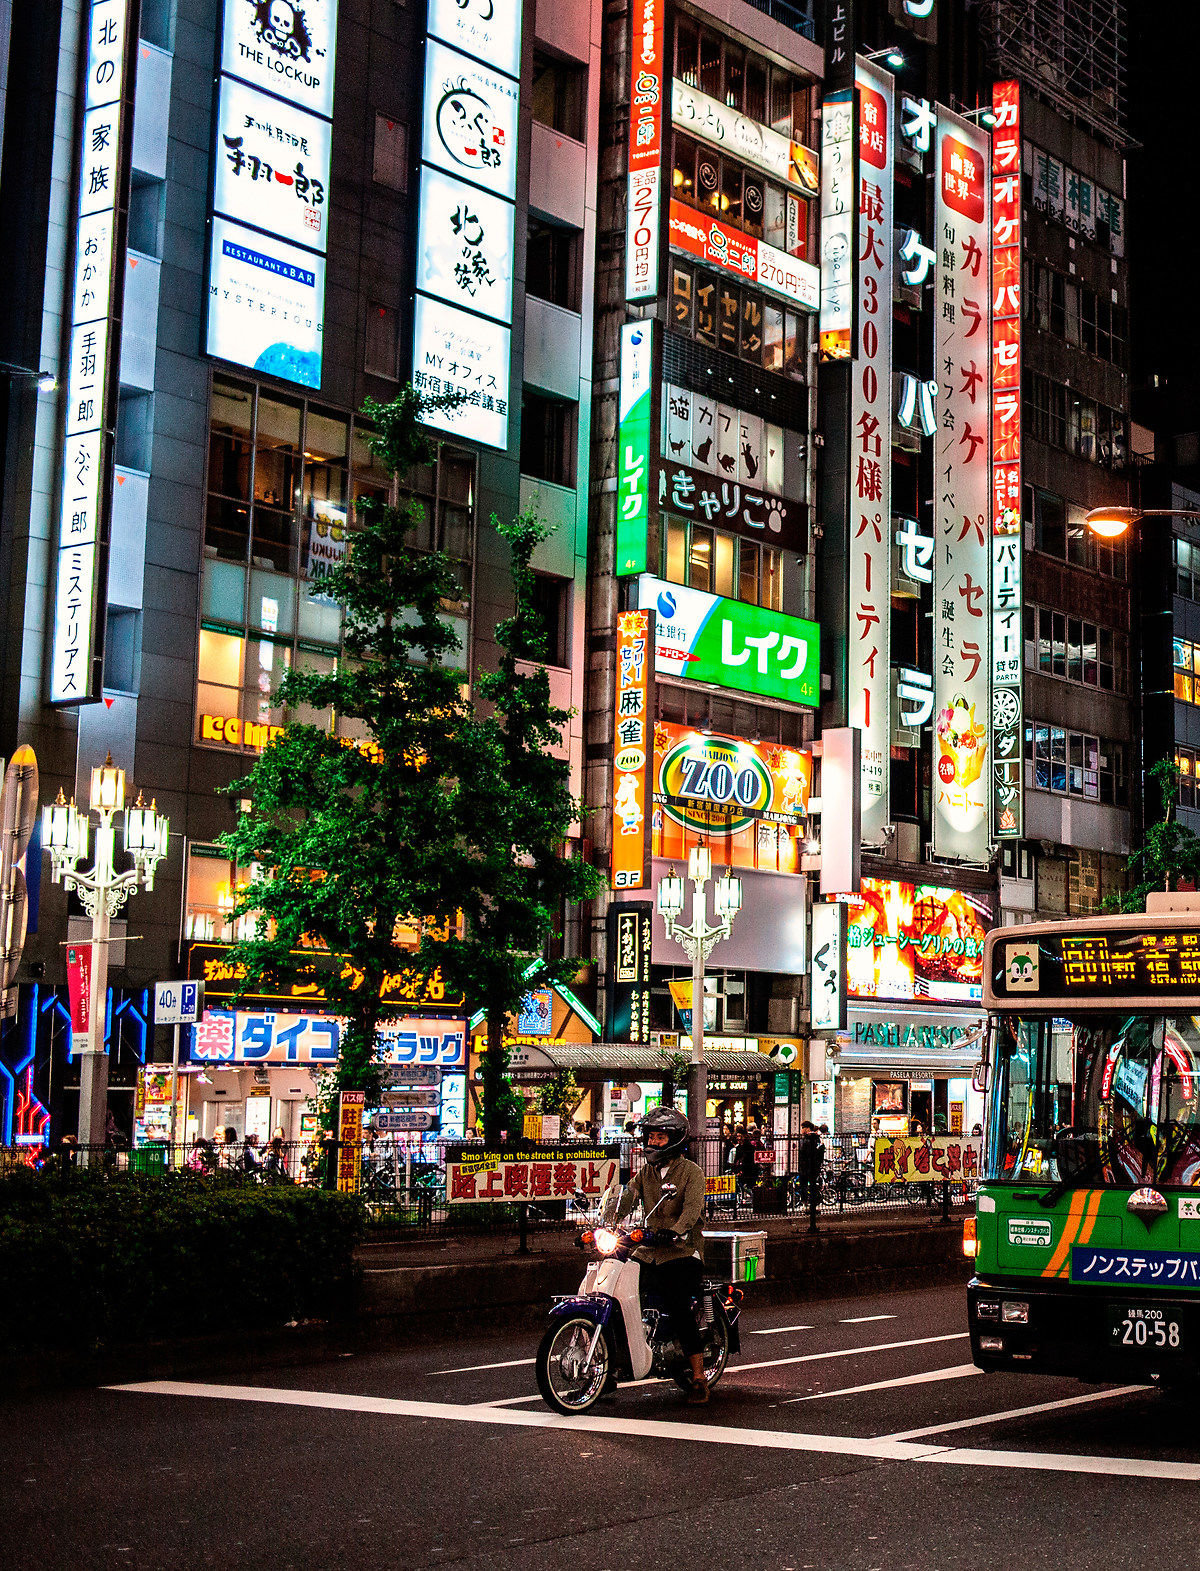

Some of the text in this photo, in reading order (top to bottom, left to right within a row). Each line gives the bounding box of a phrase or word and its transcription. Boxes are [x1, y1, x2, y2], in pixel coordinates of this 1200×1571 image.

[239, 43, 320, 89] THE LOCKUP
[89, 18, 118, 194] 北の家族
[687, 98, 725, 140] うっとり
[633, 170, 656, 188] 全品
[831, 146, 845, 215] うっとり
[944, 171, 982, 201] 世界一
[82, 237, 98, 307] おかか
[225, 245, 313, 284] RESTAURANT & BAR
[993, 99, 1020, 423] カラオケパセラ
[209, 285, 323, 332] MYSTERIOUS
[674, 269, 761, 327] ロイヤル
[675, 301, 761, 351] クリニック
[76, 332, 97, 422] 手羽一郎
[425, 352, 497, 390] MY オフィス
[414, 370, 507, 416] 新宿東口会議室
[670, 396, 749, 439] 猫カフェ
[855, 177, 885, 728] 最大300名様パーティー
[957, 236, 984, 683] カラオケパセラ
[71, 445, 91, 533] ふぐ一郎
[622, 446, 644, 519] レイク
[672, 470, 765, 528] きゃりこ
[625, 560, 636, 568] 4F
[997, 545, 1016, 653] パーティー
[62, 553, 82, 693] ミステリアス
[654, 622, 686, 642] 生銀行
[621, 646, 632, 688] セット
[633, 639, 645, 680] フリー
[721, 619, 808, 680] レイク
[996, 660, 1019, 672] 貸切
[801, 683, 813, 696] 4F
[619, 690, 643, 746] 麻雀
[620, 754, 640, 765] ZOO
[939, 763, 955, 777] 名物
[998, 735, 1018, 806] ダーツ
[679, 756, 762, 807] ZOO
[938, 791, 984, 813] ハニトー
[687, 810, 709, 820] SINCE
[763, 811, 797, 824] MAHJONG
[615, 872, 639, 887] 3F
[159, 990, 176, 1008] 40分
[182, 1005, 195, 1013] 7-20
[185, 986, 193, 1003] P
[195, 1013, 234, 1059] 薬
[855, 1022, 919, 1048] PASELA
[343, 1093, 364, 1102] バス停
[517, 1152, 530, 1160] the
[531, 1152, 554, 1160] street
[557, 1151, 563, 1159] is
[566, 1150, 607, 1161] prohibited.
[1112, 1320, 1180, 1347] か 20-58
[1128, 1309, 1163, 1320] 練馬 200
